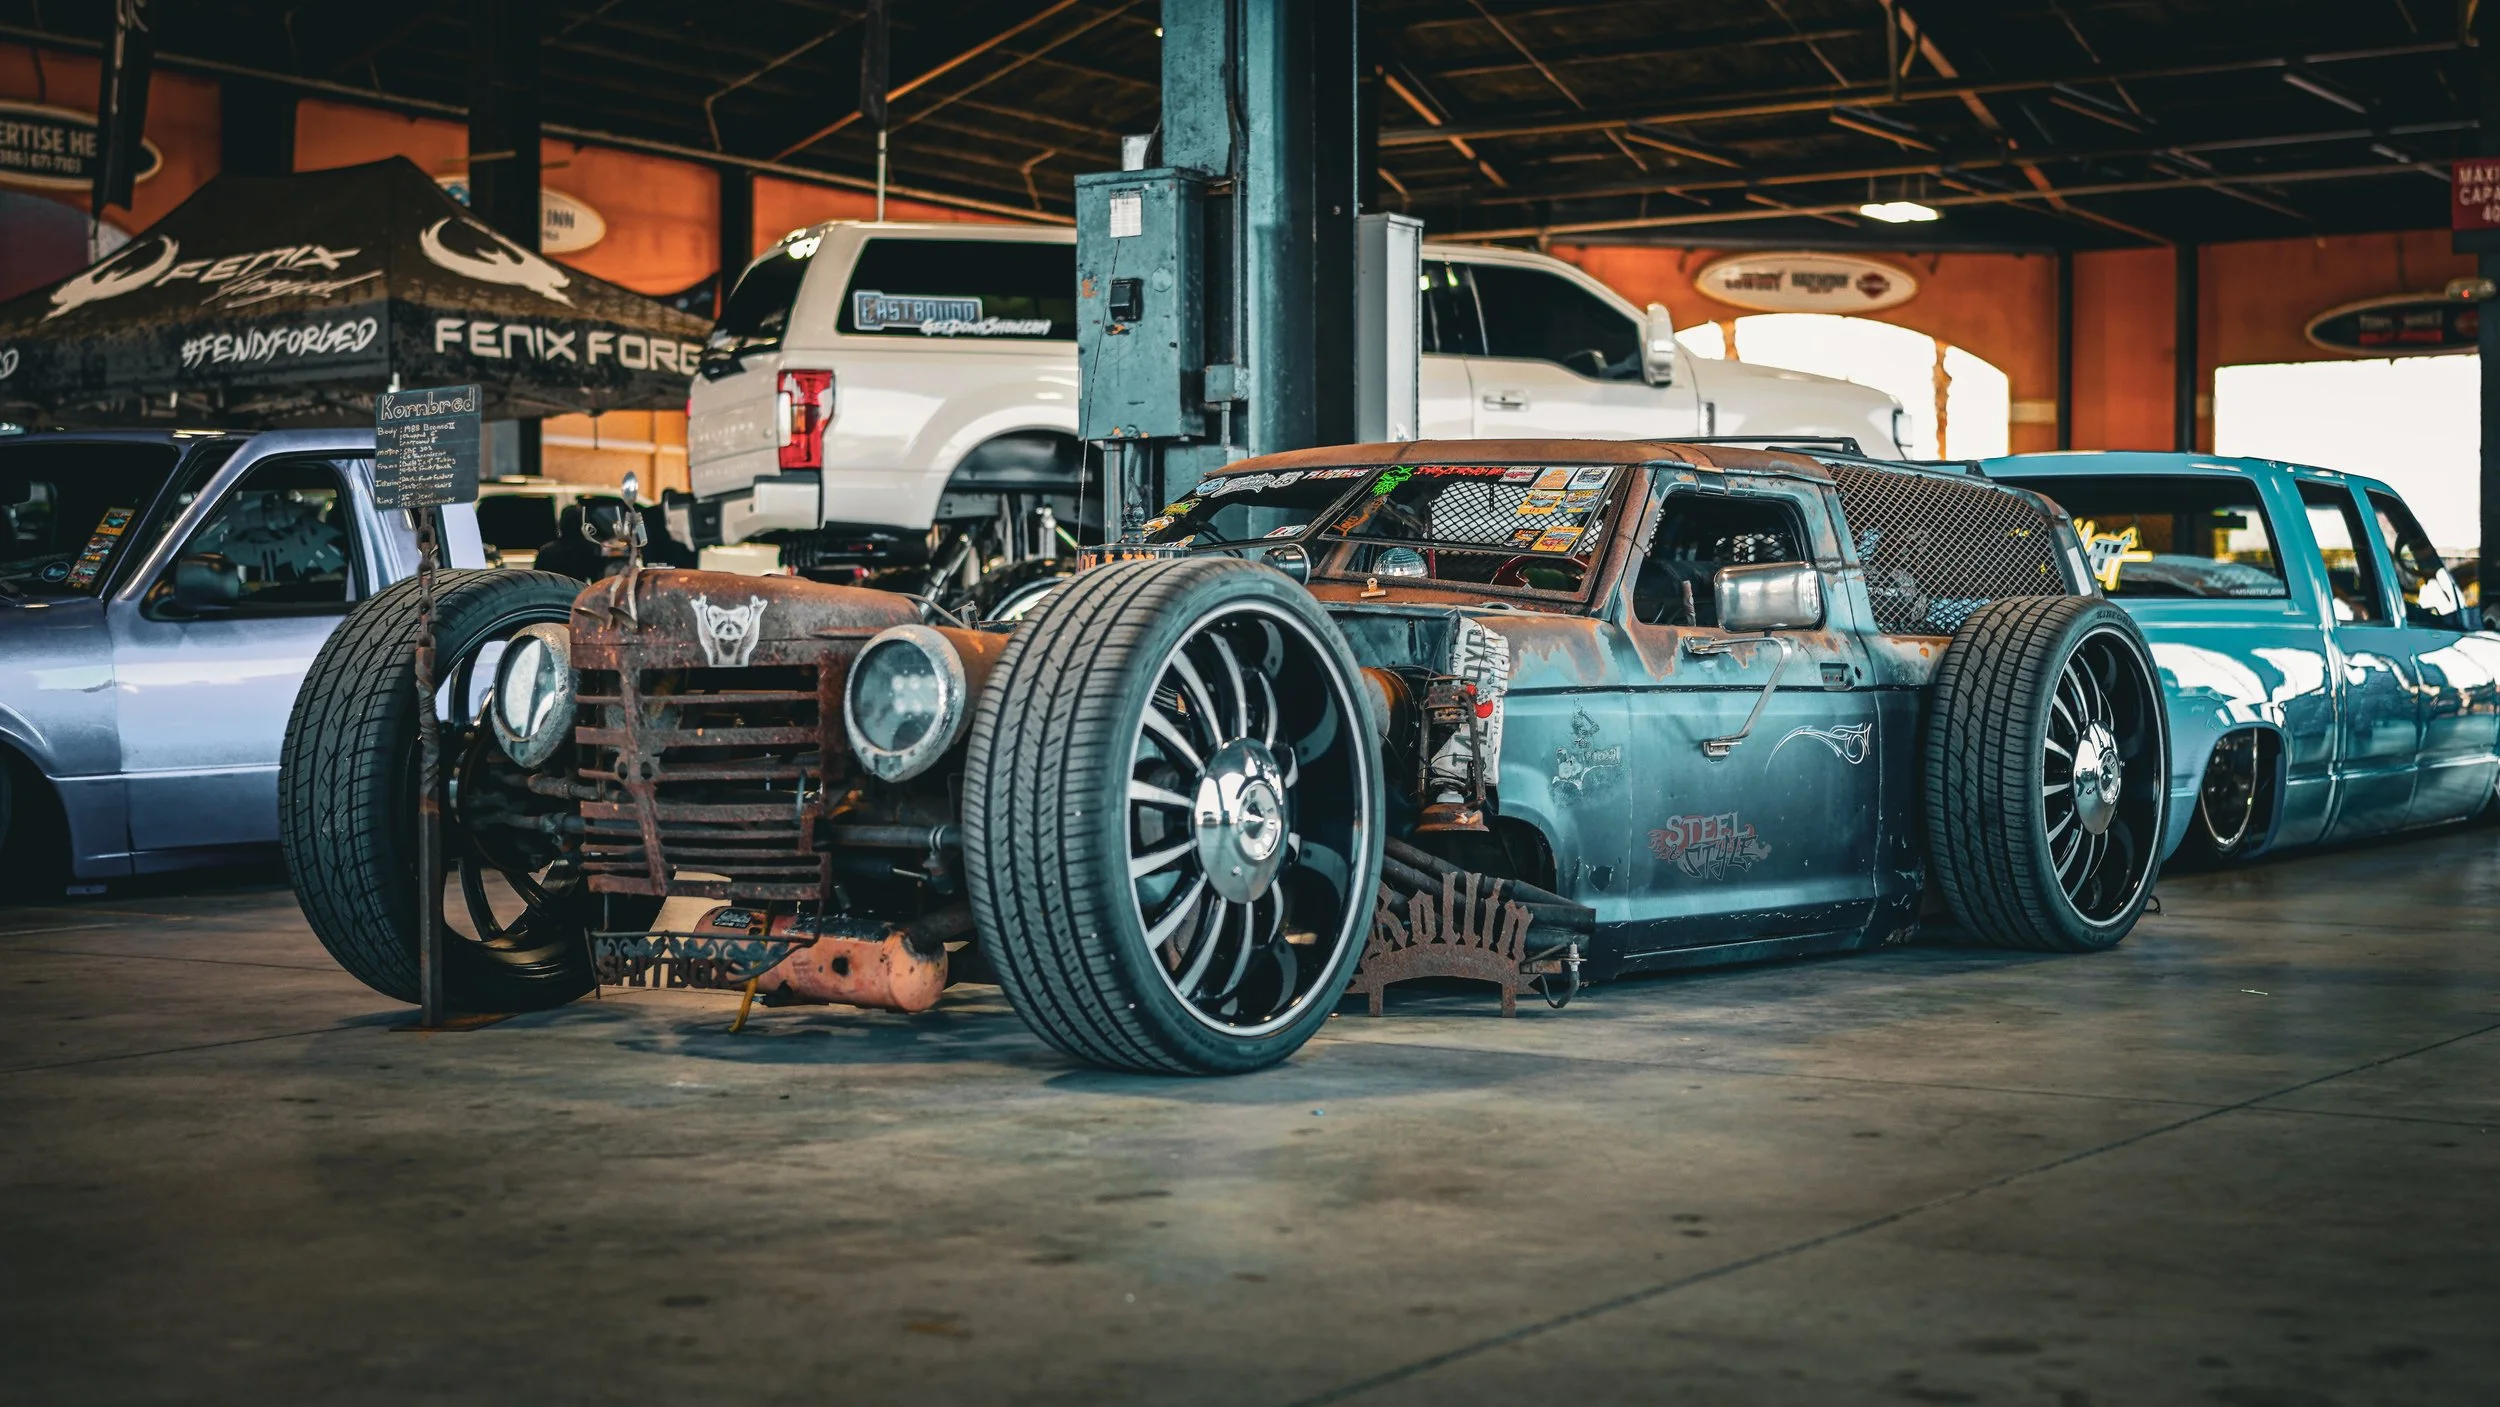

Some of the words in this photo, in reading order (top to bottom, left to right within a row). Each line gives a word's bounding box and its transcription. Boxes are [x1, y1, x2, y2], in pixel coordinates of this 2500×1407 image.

[861, 297, 976, 324] EASTBOUND
[435, 318, 577, 363] FENIX
[381, 386, 475, 421] Kornbred
[1665, 810, 1751, 848] STEEL
[1682, 834, 1758, 880] STYLE
